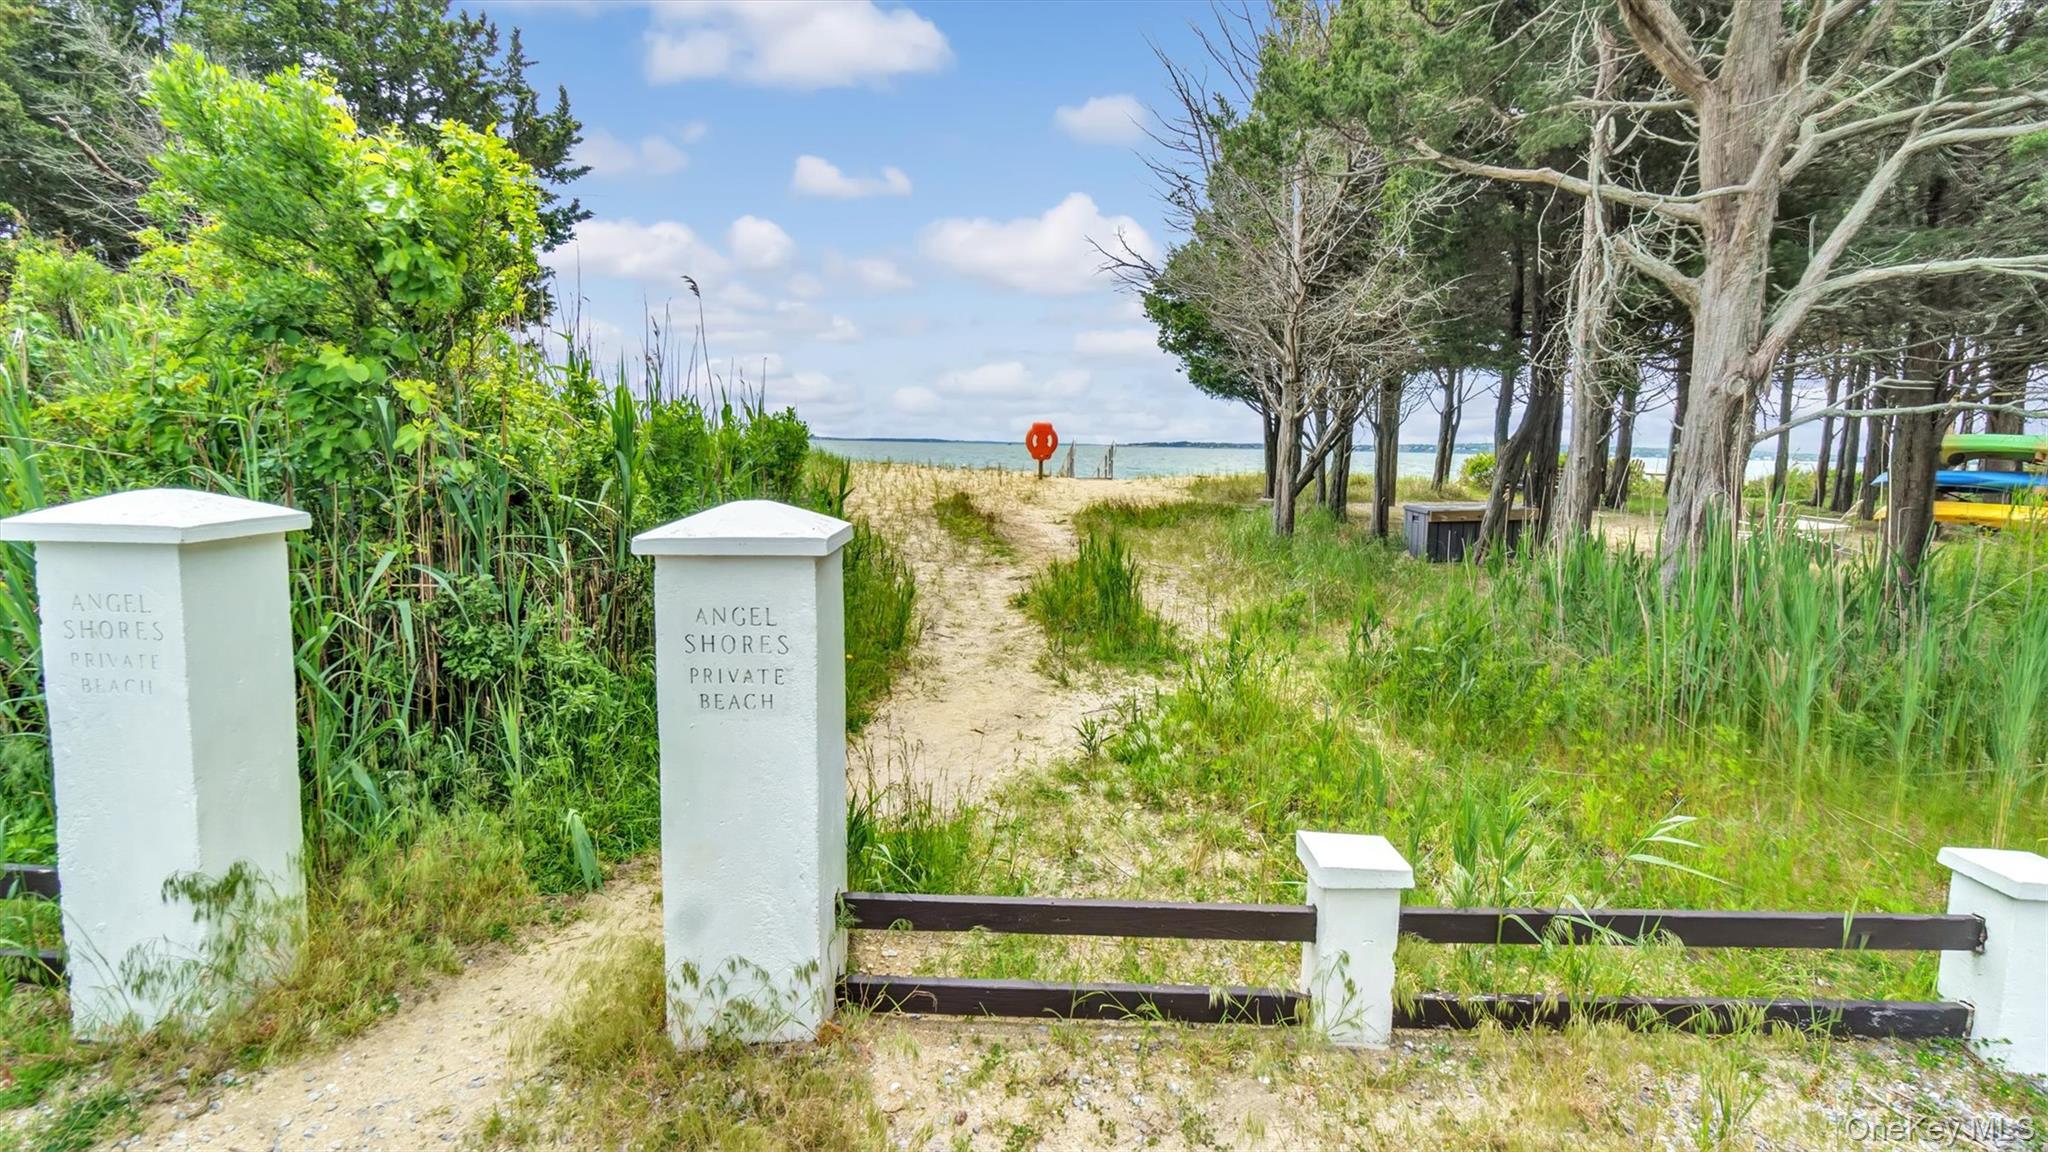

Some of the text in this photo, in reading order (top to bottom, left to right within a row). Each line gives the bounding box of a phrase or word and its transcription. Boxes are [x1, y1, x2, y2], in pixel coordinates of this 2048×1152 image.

[72, 593, 151, 613] ANGEL
[696, 607, 777, 626] ANGEL
[64, 619, 164, 641] SHORES
[685, 634, 789, 654] SHORES
[71, 652, 160, 670] PRIVATE
[690, 667, 784, 685] PRIVATE
[81, 678, 153, 695] BEACH
[700, 693, 774, 710] BEACH
